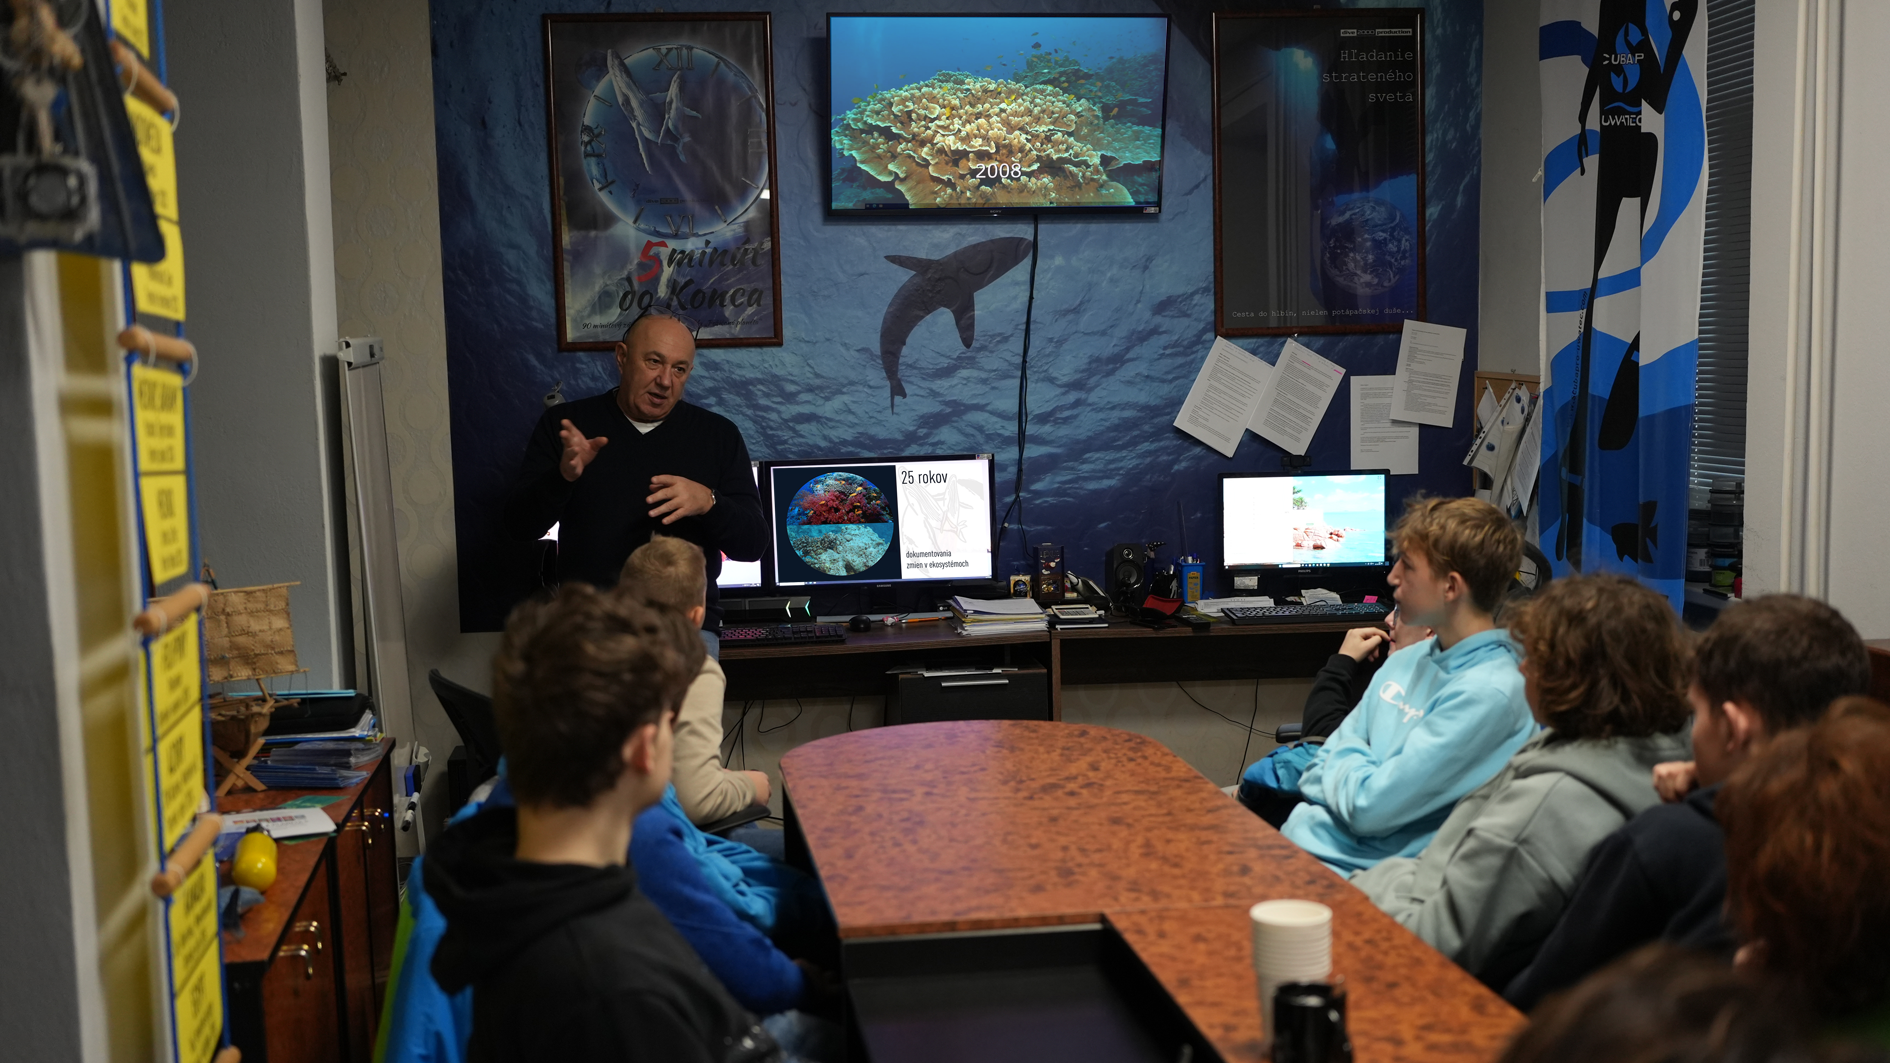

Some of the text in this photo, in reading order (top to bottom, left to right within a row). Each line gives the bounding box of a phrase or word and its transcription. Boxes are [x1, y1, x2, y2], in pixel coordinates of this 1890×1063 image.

[652, 47, 694, 70] XII
[1340, 49, 1414, 61] Hľadanie
[1322, 69, 1414, 82] strateného
[1368, 91, 1414, 102] sveta
[975, 163, 1022, 178] 2008
[635, 237, 765, 282] 5 minút
[618, 275, 764, 312] do Konca
[1301, 308, 1328, 316] nielen
[901, 469, 948, 485] 25 rokov
[905, 549, 952, 558] dokumentovania
[906, 561, 924, 569] zmien
[928, 560, 969, 570] ekosystémoch
